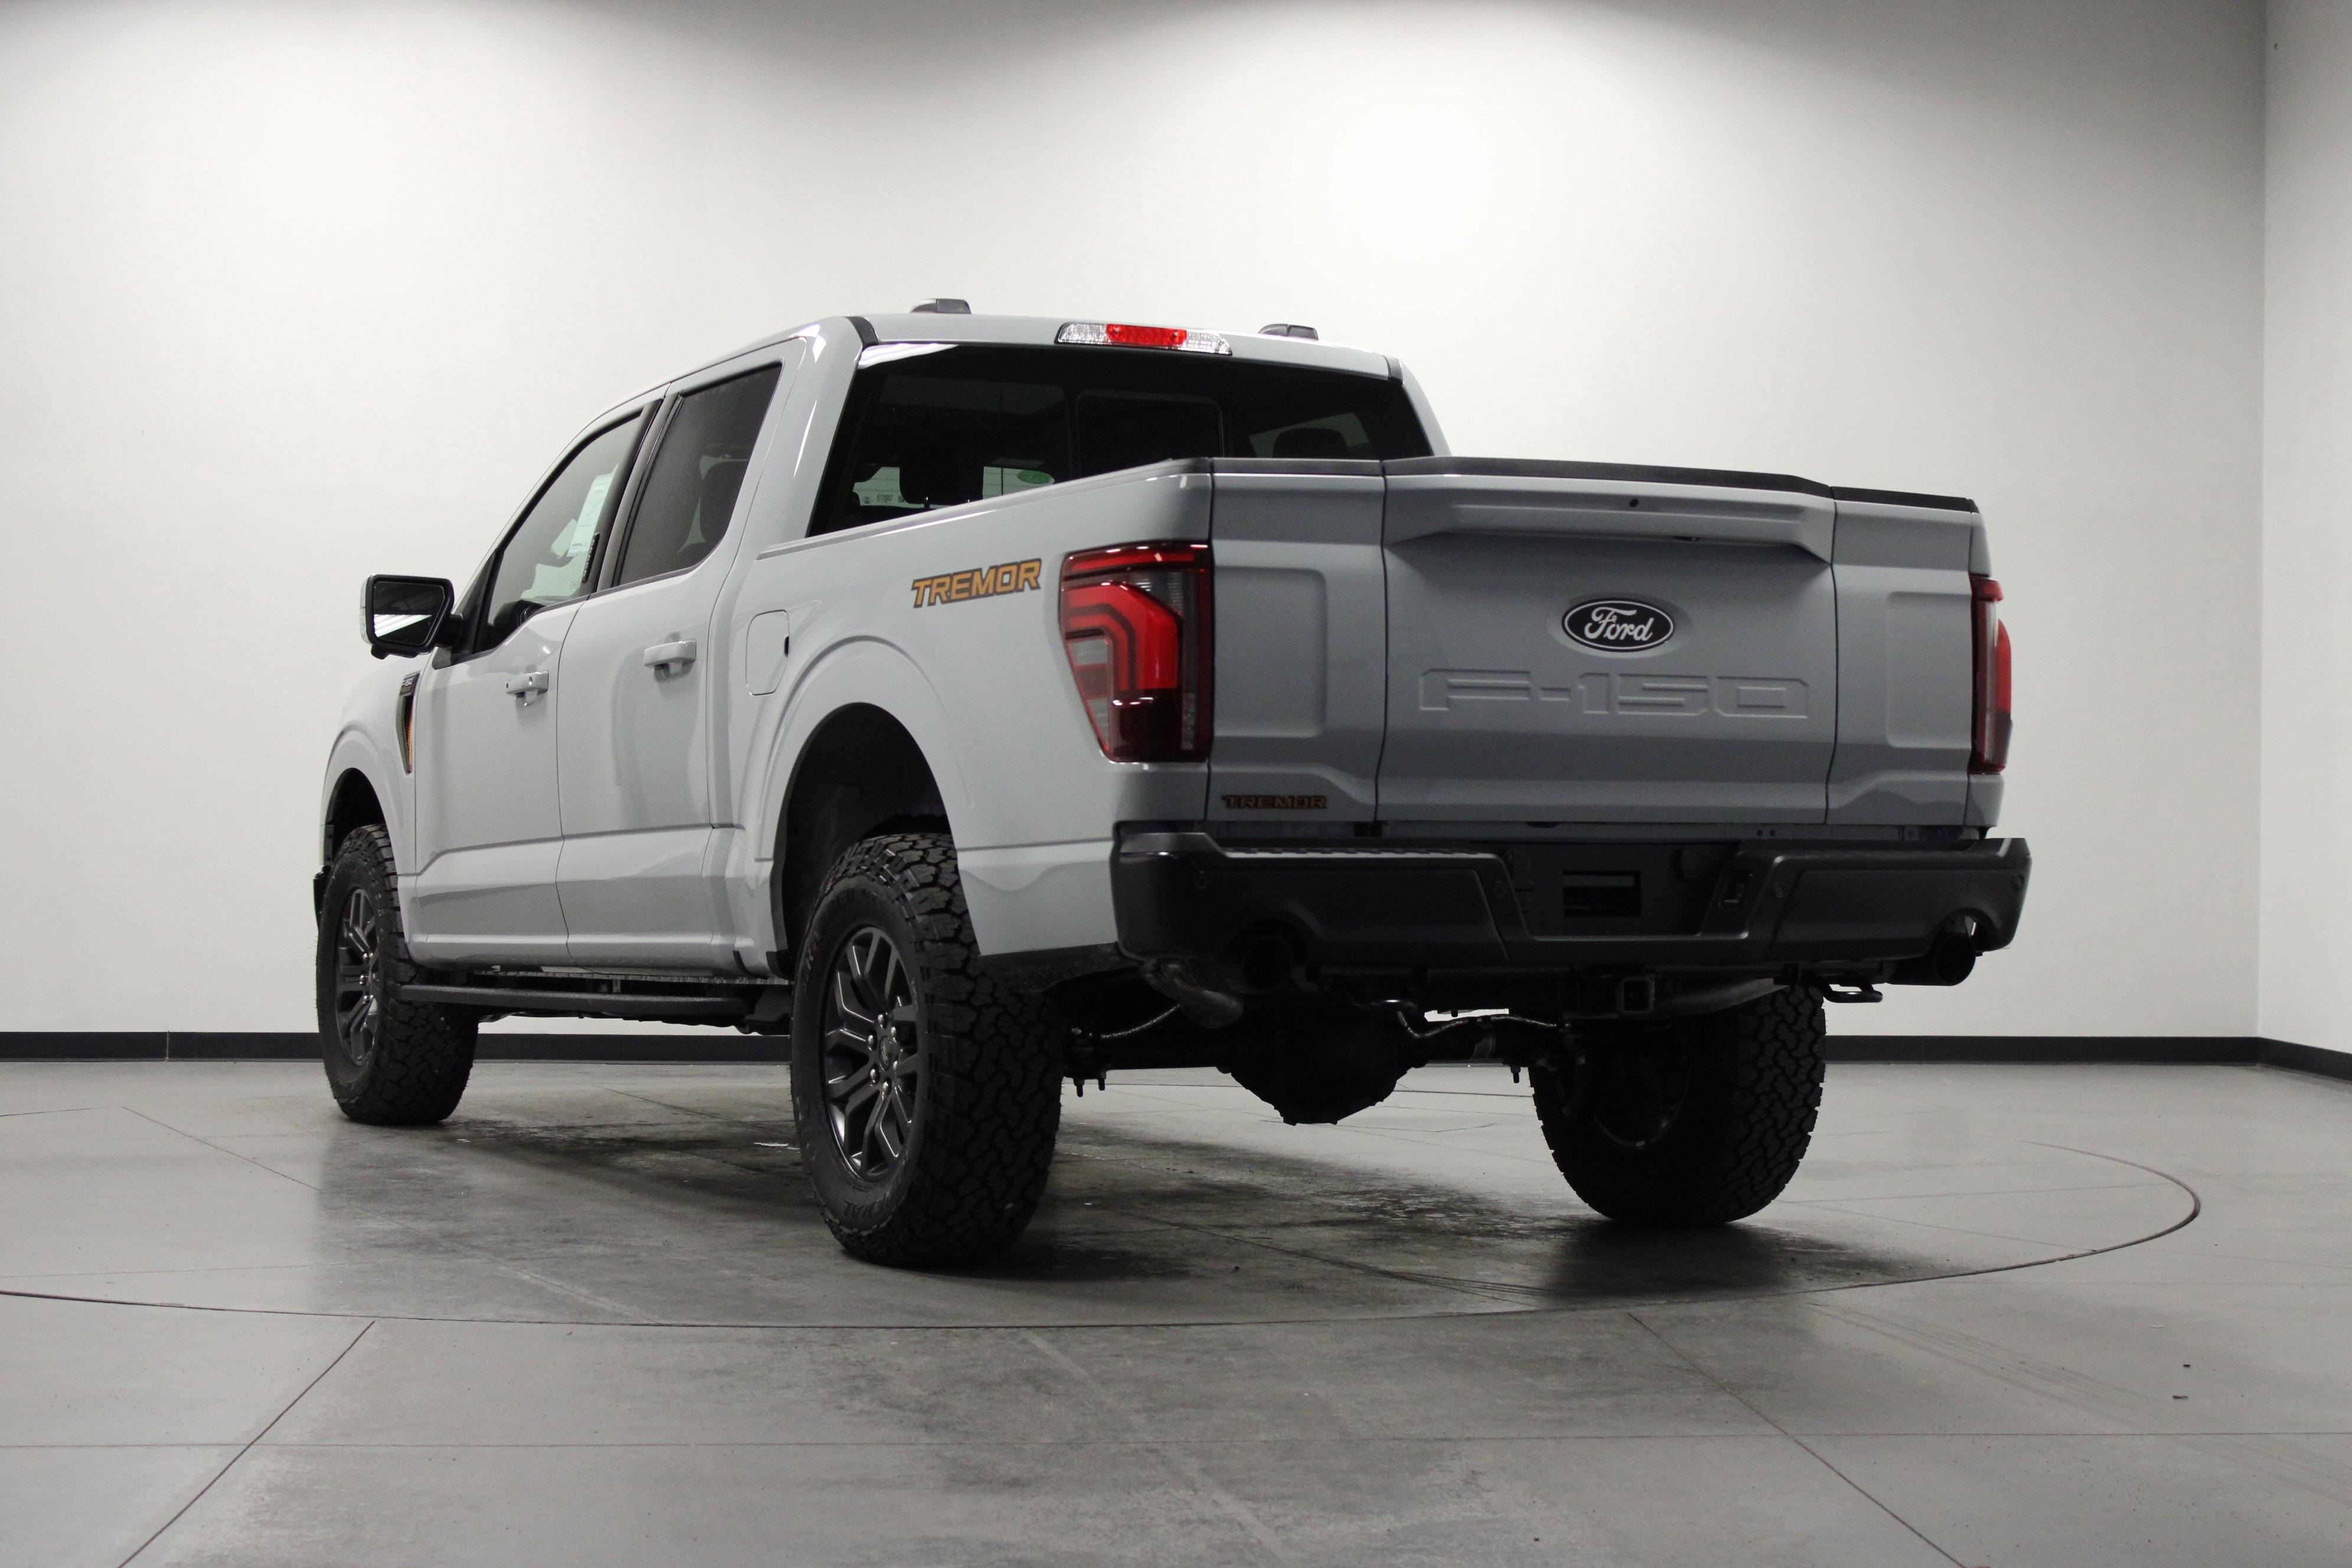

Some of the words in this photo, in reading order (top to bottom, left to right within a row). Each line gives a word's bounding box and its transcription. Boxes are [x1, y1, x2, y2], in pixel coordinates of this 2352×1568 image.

[911, 558, 1041, 608] TREMOR
[1584, 606, 1654, 641] Ford
[1420, 668, 1809, 719] F-150
[1222, 795, 1327, 809] TREMOR
